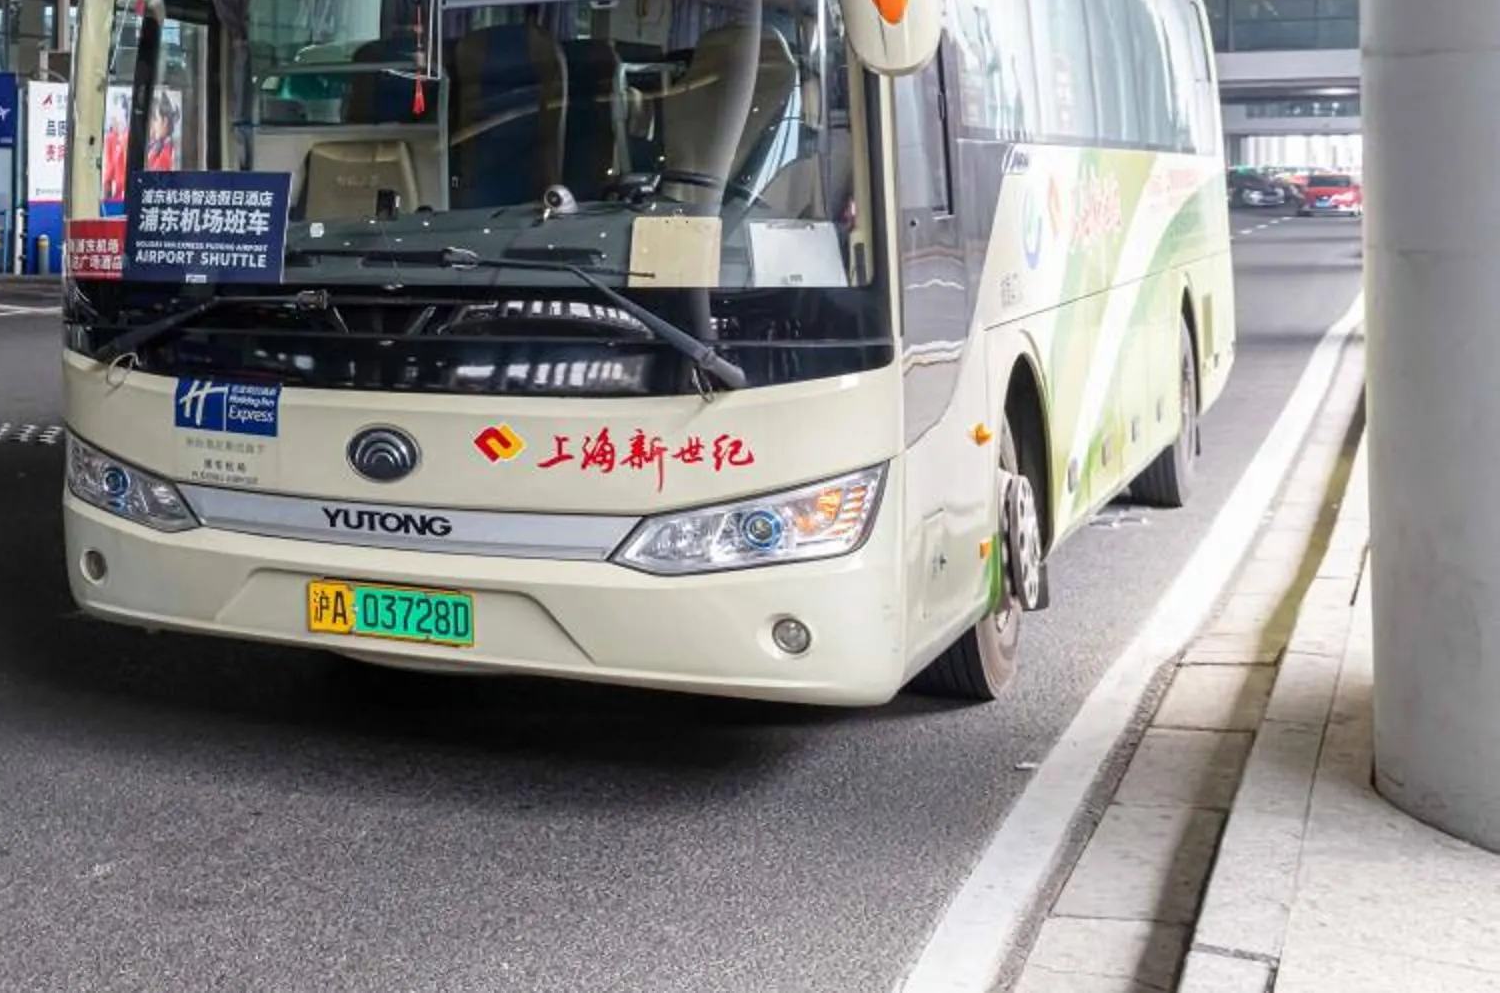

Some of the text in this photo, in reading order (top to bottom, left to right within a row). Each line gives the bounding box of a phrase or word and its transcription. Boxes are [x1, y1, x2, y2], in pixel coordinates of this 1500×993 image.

[138, 207, 271, 236] 浦东机场班车
[135, 249, 267, 268] AIRPORT SHUTTLE
[228, 405, 275, 423] Express
[537, 427, 755, 493] 上海新世纪
[322, 507, 453, 537] YUTONG
